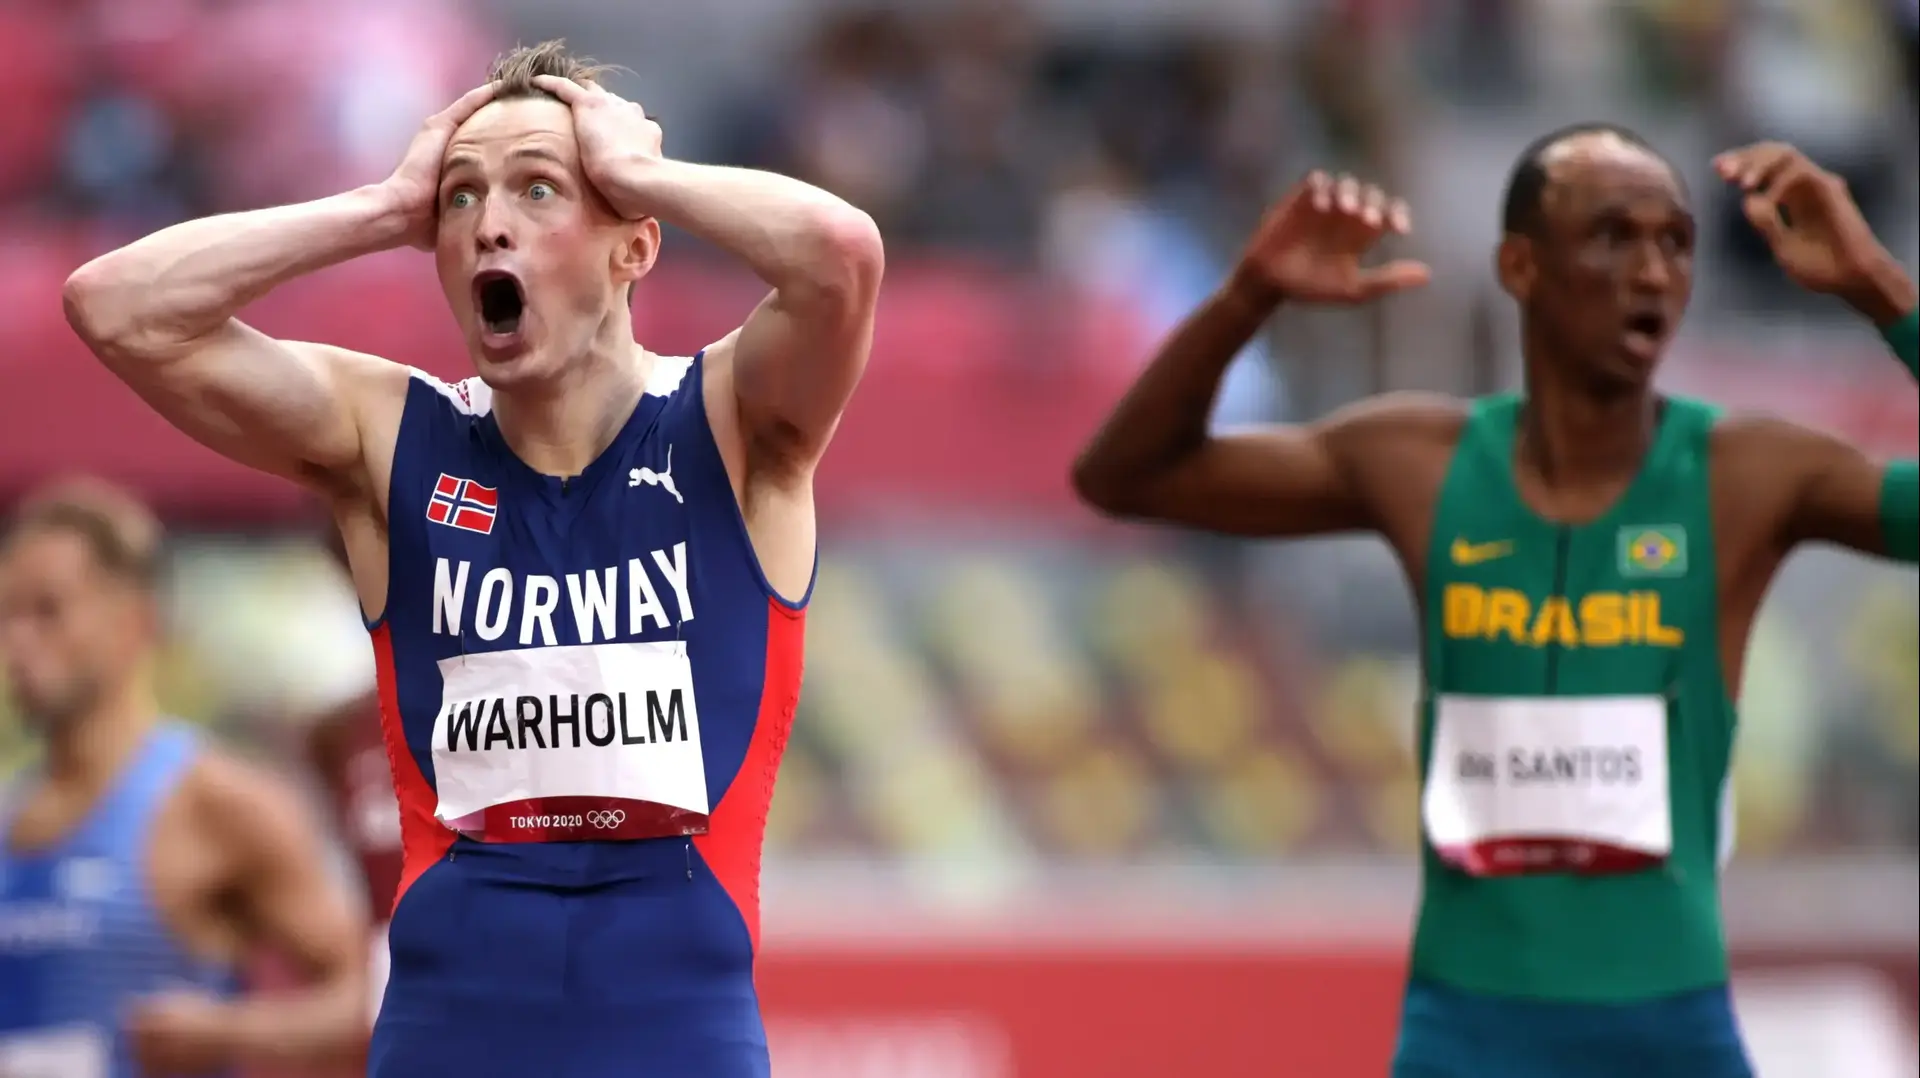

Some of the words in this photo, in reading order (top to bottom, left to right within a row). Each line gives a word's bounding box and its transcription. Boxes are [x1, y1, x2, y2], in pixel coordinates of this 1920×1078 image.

[432, 541, 694, 645] NORWAY
[1444, 584, 1684, 646] BRASIL
[447, 688, 688, 752] WARHOLM
[1508, 748, 1641, 784] SANTOS
[510, 816, 550, 828] TOKYO
[552, 814, 583, 828] 2020
